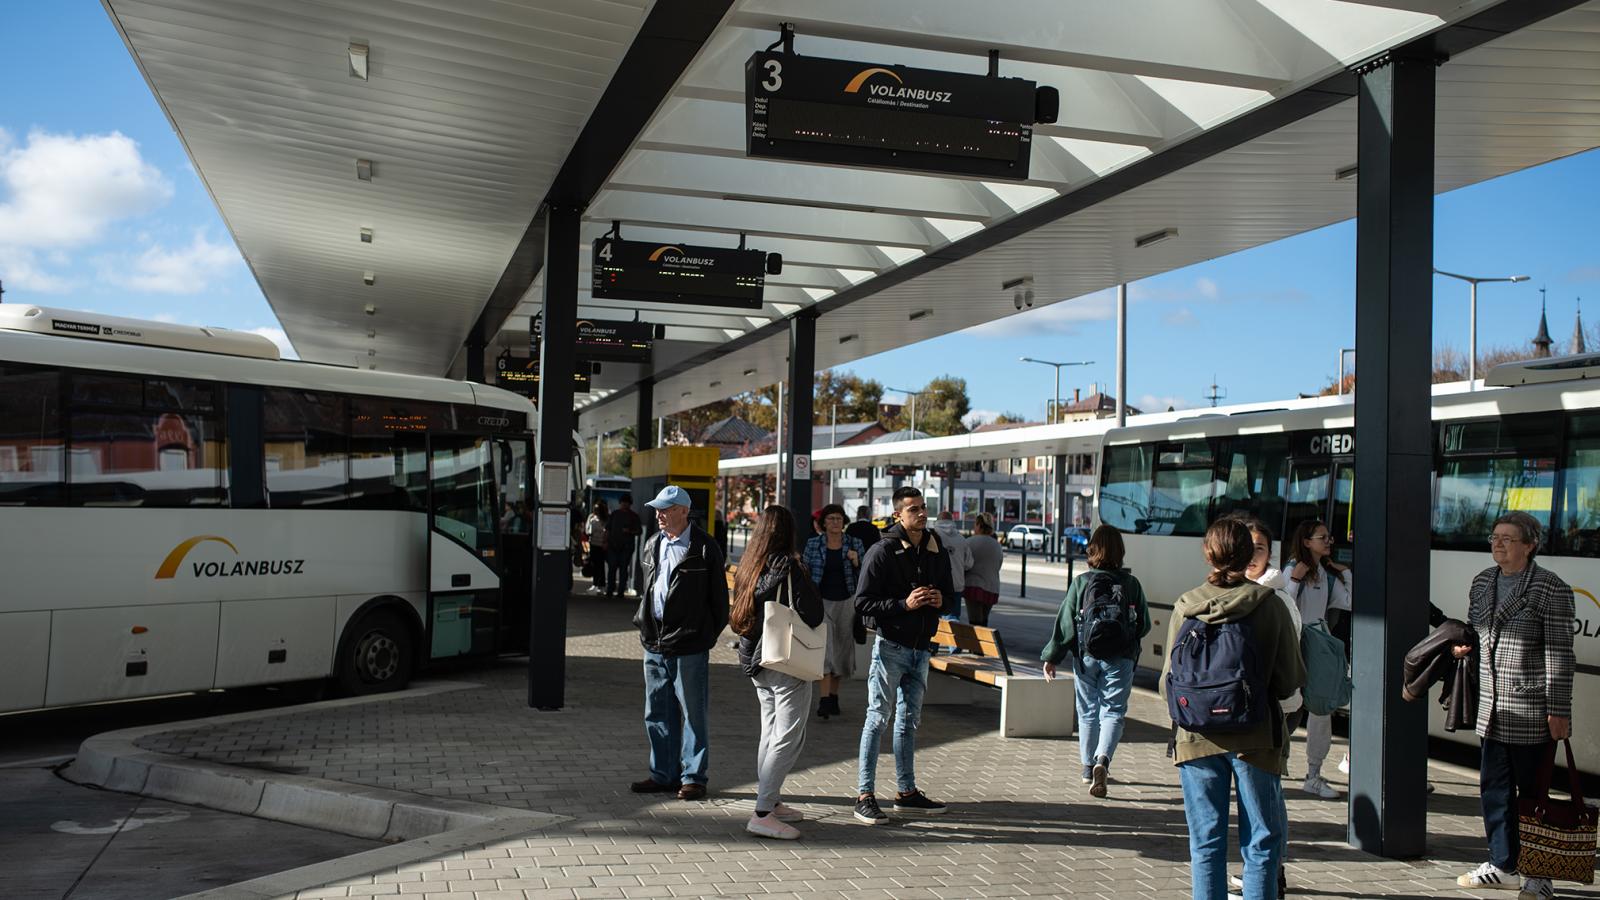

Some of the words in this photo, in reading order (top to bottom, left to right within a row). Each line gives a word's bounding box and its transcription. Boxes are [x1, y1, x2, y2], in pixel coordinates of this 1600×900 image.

[762, 59, 783, 92] 3
[870, 84, 952, 103] VOLÁNBUSZ
[899, 101, 929, 109] Destination
[599, 242, 613, 262] 4
[533, 319, 542, 333] 5
[498, 359, 506, 370] 6
[478, 416, 510, 427] CREDO
[1310, 434, 1355, 455] CRED
[193, 559, 305, 578] VOLÁNBUSZ
